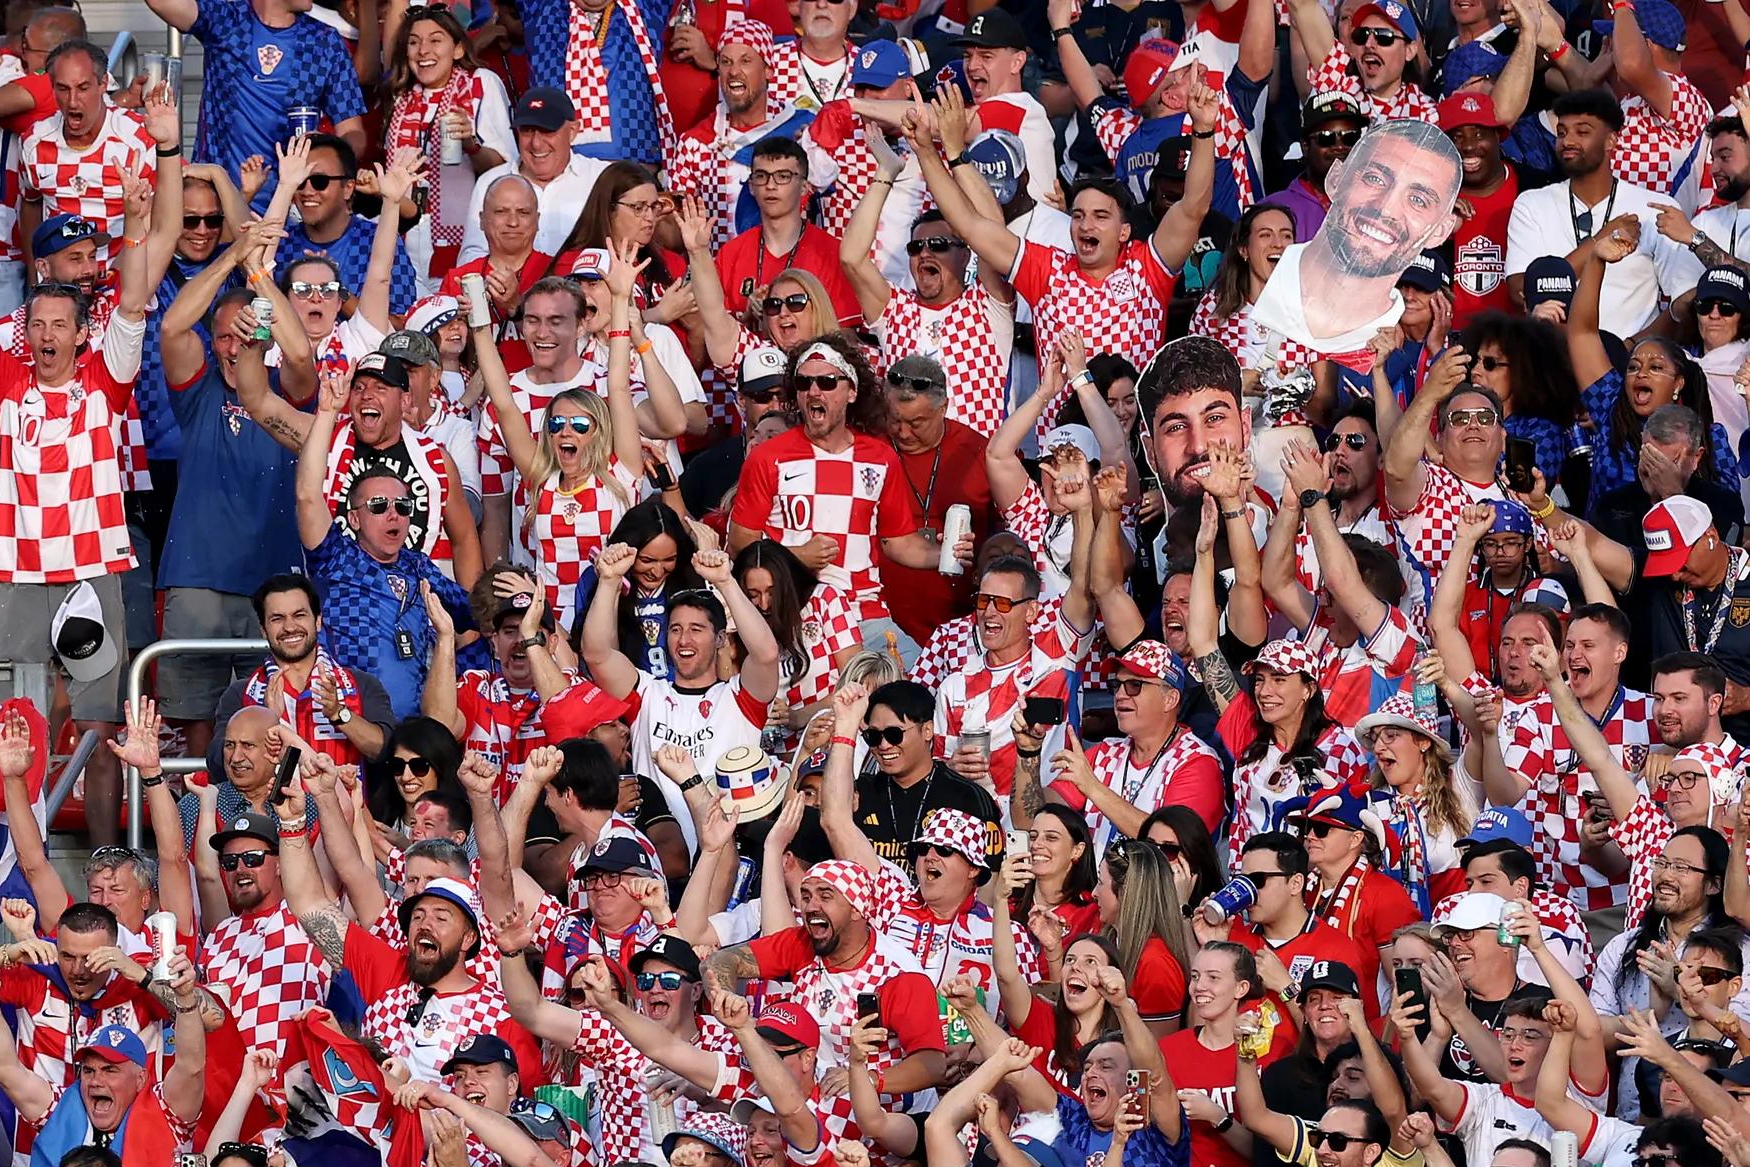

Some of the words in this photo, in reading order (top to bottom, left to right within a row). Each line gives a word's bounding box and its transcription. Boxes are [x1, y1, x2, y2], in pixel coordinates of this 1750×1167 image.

[1456, 263, 1504, 272] TORONTO
[403, 465, 429, 511] YOU
[780, 496, 811, 532] 10
[648, 646, 669, 678] 9
[653, 721, 714, 748] Emirates
[951, 940, 993, 955] CROAT
